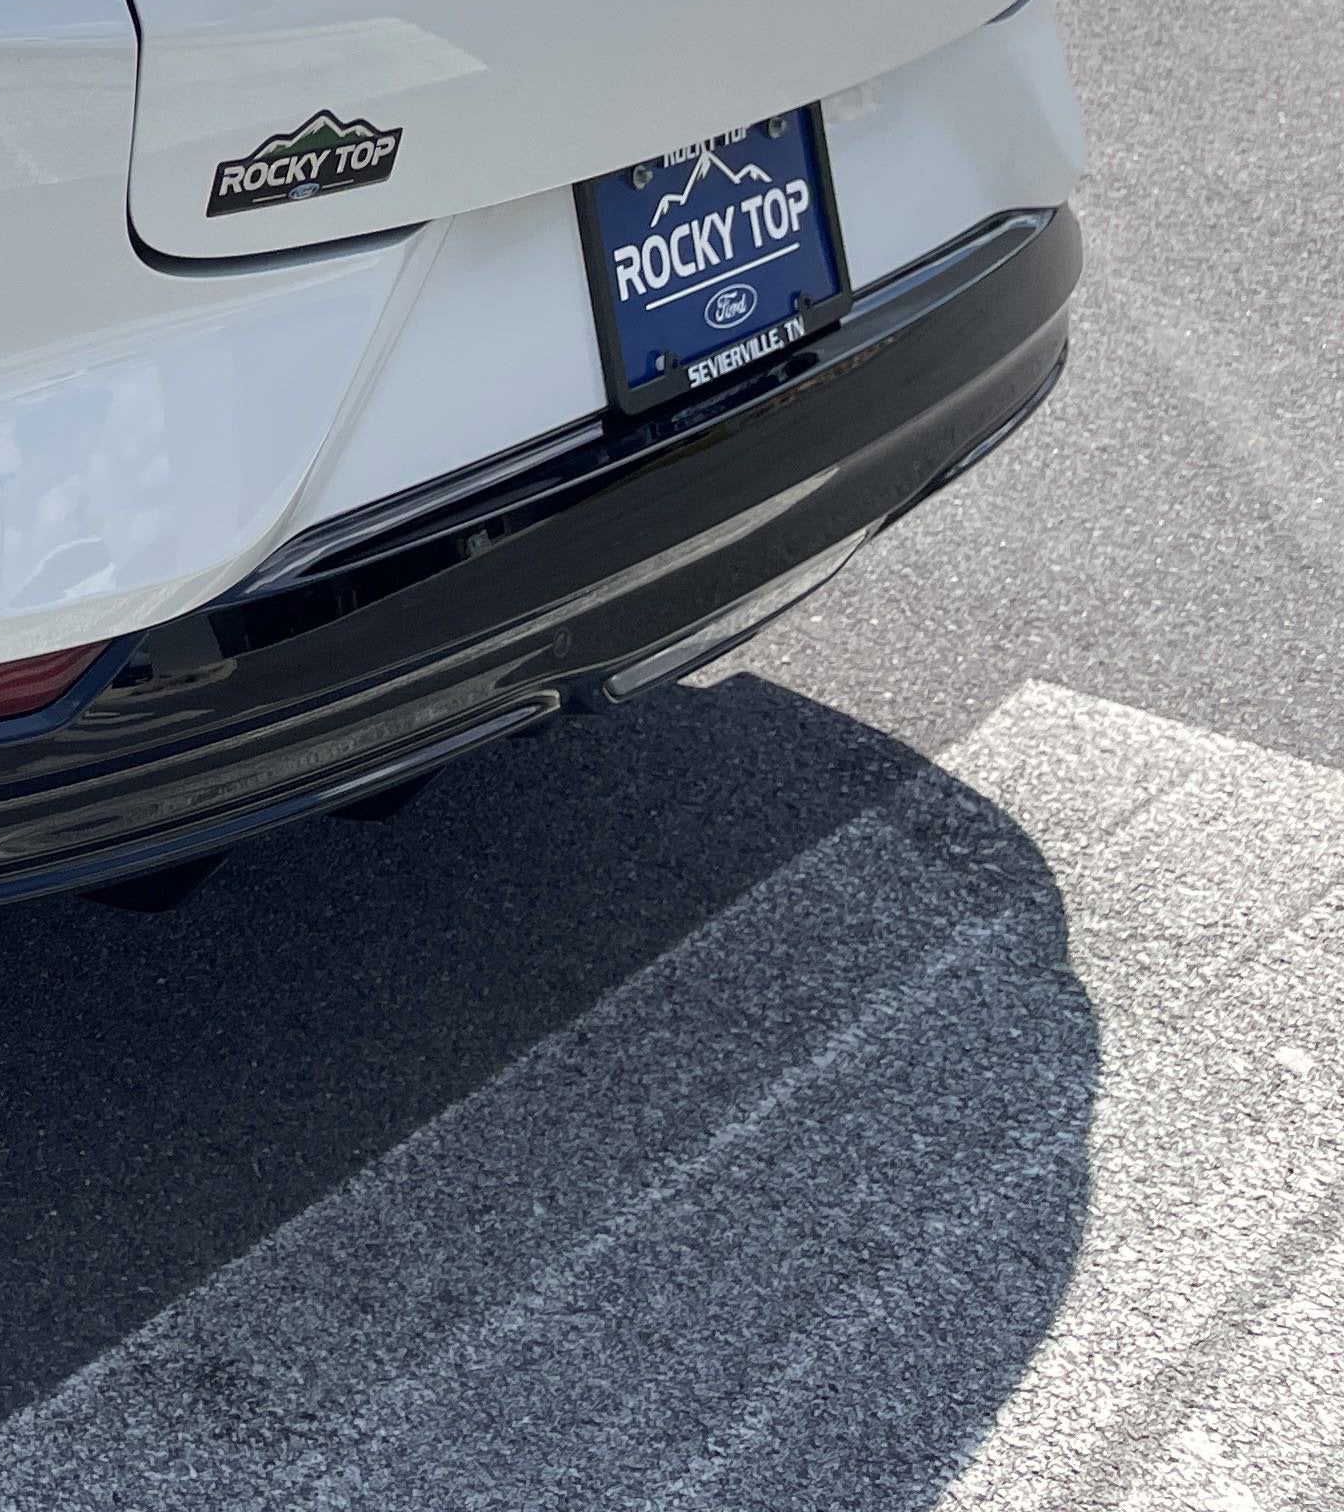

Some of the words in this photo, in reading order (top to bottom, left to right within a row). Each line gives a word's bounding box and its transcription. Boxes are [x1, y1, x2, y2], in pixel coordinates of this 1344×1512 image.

[219, 149, 331, 196] ROCKY
[336, 136, 395, 174] TOP
[614, 205, 735, 301] ROCKY
[741, 178, 810, 248] TOP
[688, 327, 785, 388] SEVIERVILLE,
[784, 315, 805, 342] TN
